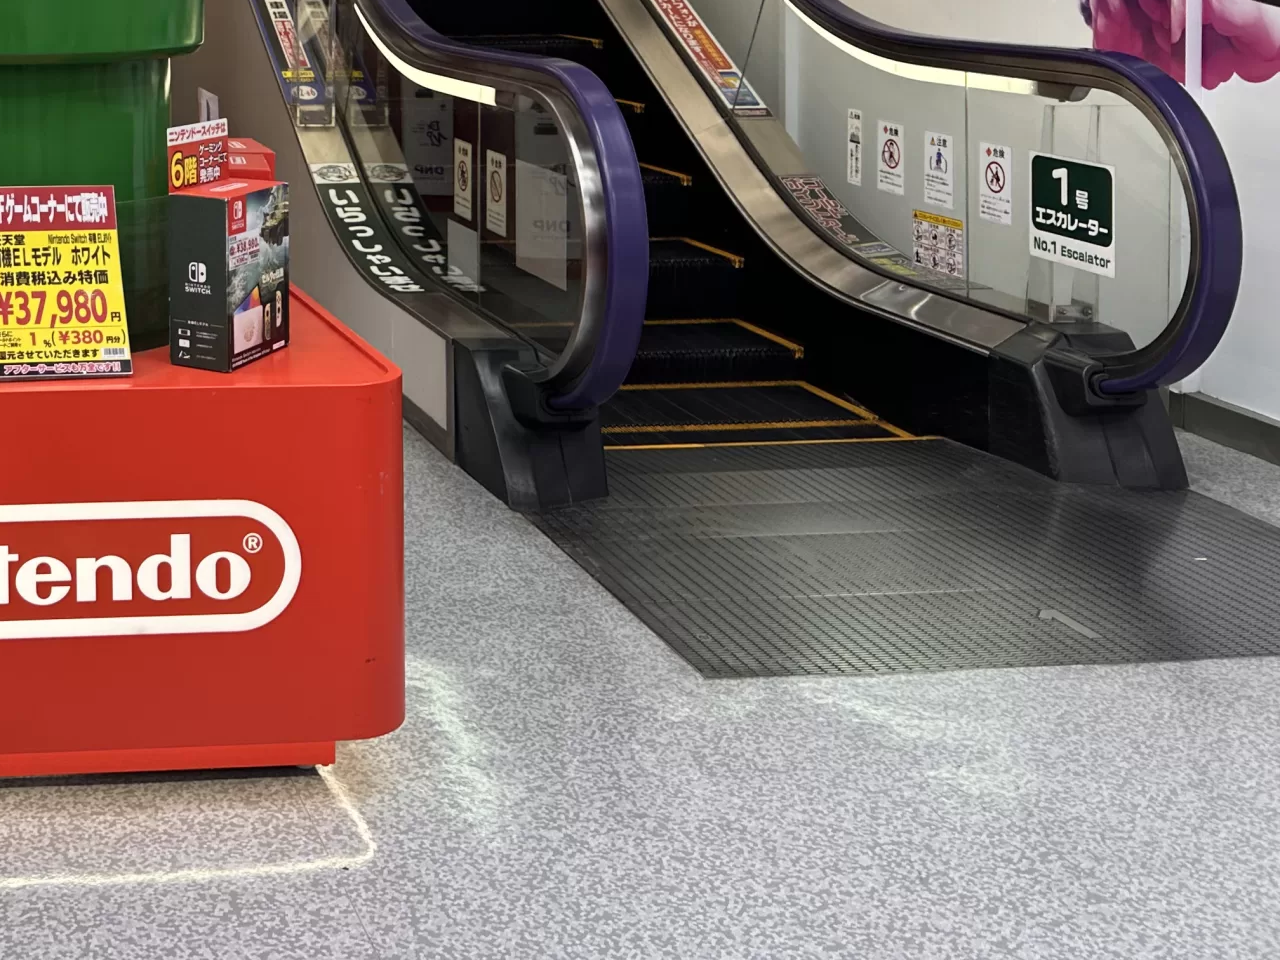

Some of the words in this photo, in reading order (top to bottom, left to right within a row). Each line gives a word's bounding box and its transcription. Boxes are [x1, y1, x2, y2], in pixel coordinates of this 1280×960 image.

[169, 122, 226, 142] ニンテンドースイッチは
[171, 152, 198, 188] 6階
[1051, 167, 1089, 211] 1号
[1035, 205, 1109, 239] エスカレーター
[71, 245, 111, 266] ホワイト
[1033, 235, 1058, 254] No.1
[1060, 244, 1111, 270] Escalator
[0, 269, 109, 287] 消費税込み特価
[111, 311, 122, 322] 円
